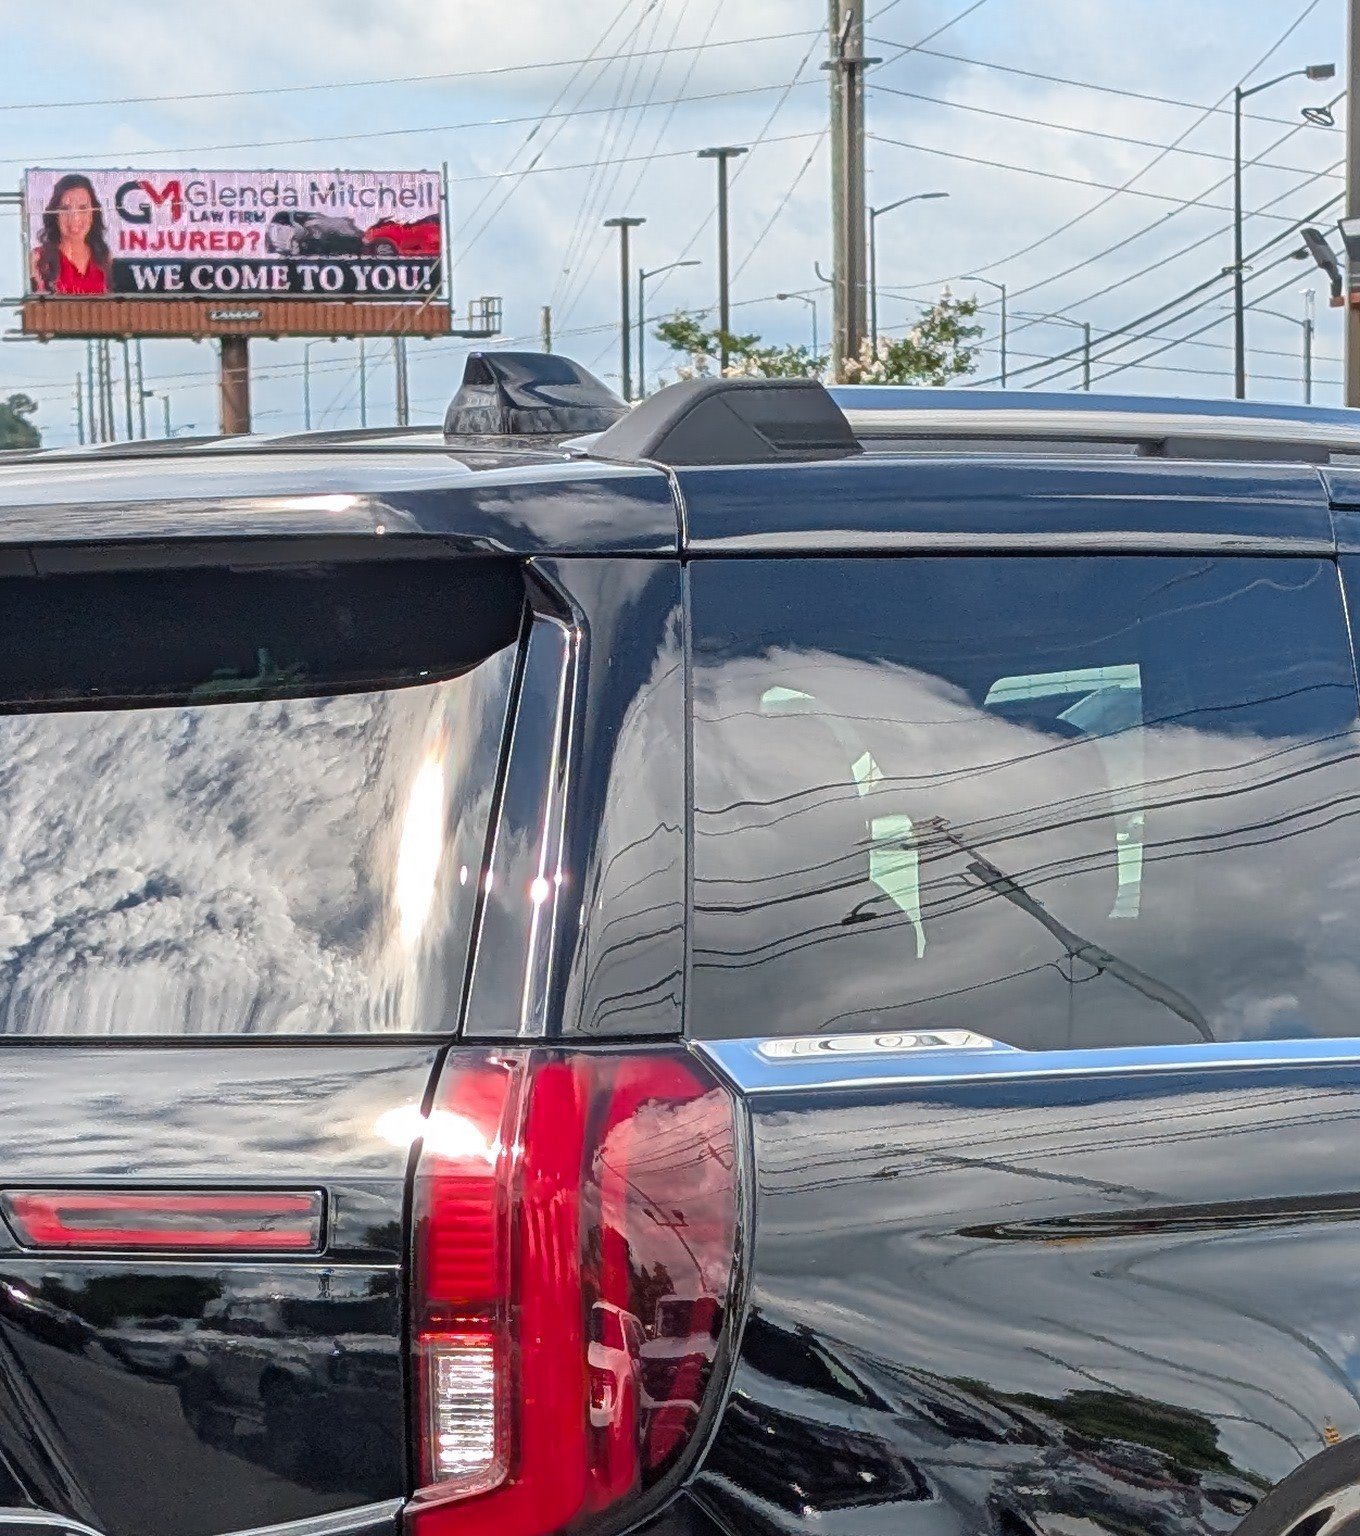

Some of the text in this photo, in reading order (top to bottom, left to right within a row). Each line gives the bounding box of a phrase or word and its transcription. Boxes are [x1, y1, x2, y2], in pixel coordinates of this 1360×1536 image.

[115, 180, 182, 224] GM
[184, 180, 434, 208] Glenda Mitchell
[190, 210, 266, 223] LAW FIRM
[119, 230, 261, 251] INJURED?
[129, 264, 432, 291] WE COME TO YOU!
